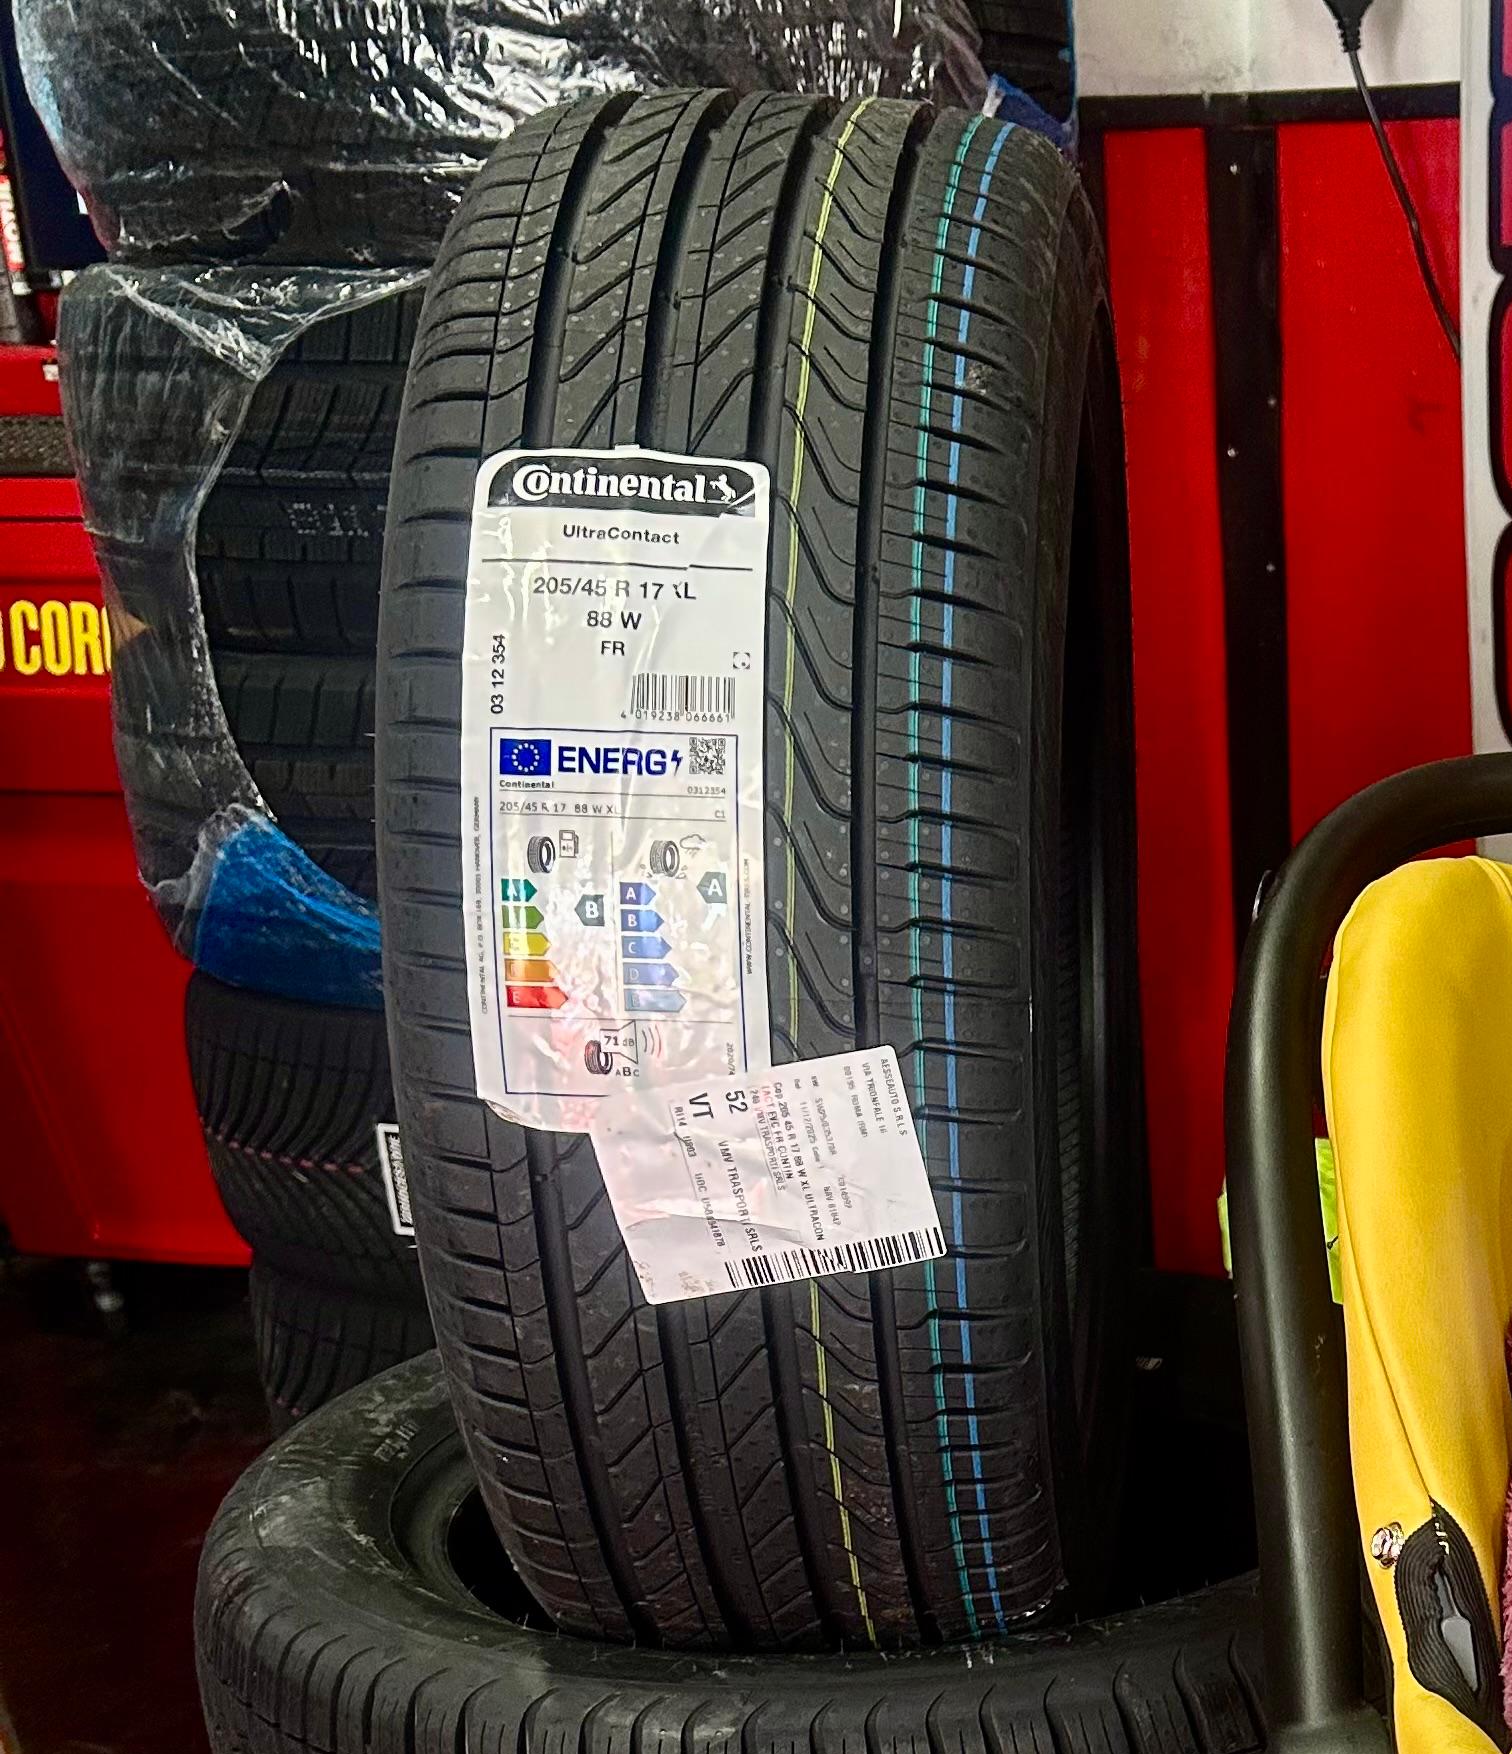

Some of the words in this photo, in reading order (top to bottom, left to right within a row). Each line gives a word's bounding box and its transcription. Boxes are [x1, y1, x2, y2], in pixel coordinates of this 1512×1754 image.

[512, 463, 706, 503] Continental
[563, 524, 680, 545] UltraContact
[533, 577, 607, 597] 205/45
[615, 580, 630, 597] R
[640, 581, 664, 600] 17
[587, 610, 613, 628] 88
[620, 611, 642, 630] W
[492, 634, 506, 663] 354
[601, 640, 625, 656] FR
[492, 668, 505, 690] 12
[490, 695, 504, 714] 03
[558, 746, 667, 775] ENERG
[499, 779, 555, 789] Continental
[499, 801, 538, 813] 205/45
[553, 803, 566, 814] 17
[574, 804, 588, 814] 88
[592, 805, 603, 815] W
[626, 887, 636, 900] A
[708, 879, 723, 897] A
[585, 901, 598, 918] B
[628, 915, 637, 927] B
[628, 942, 636, 954] C
[604, 1035, 619, 1046] 71
[688, 1092, 714, 1123] VT
[724, 1088, 748, 1115] 52
